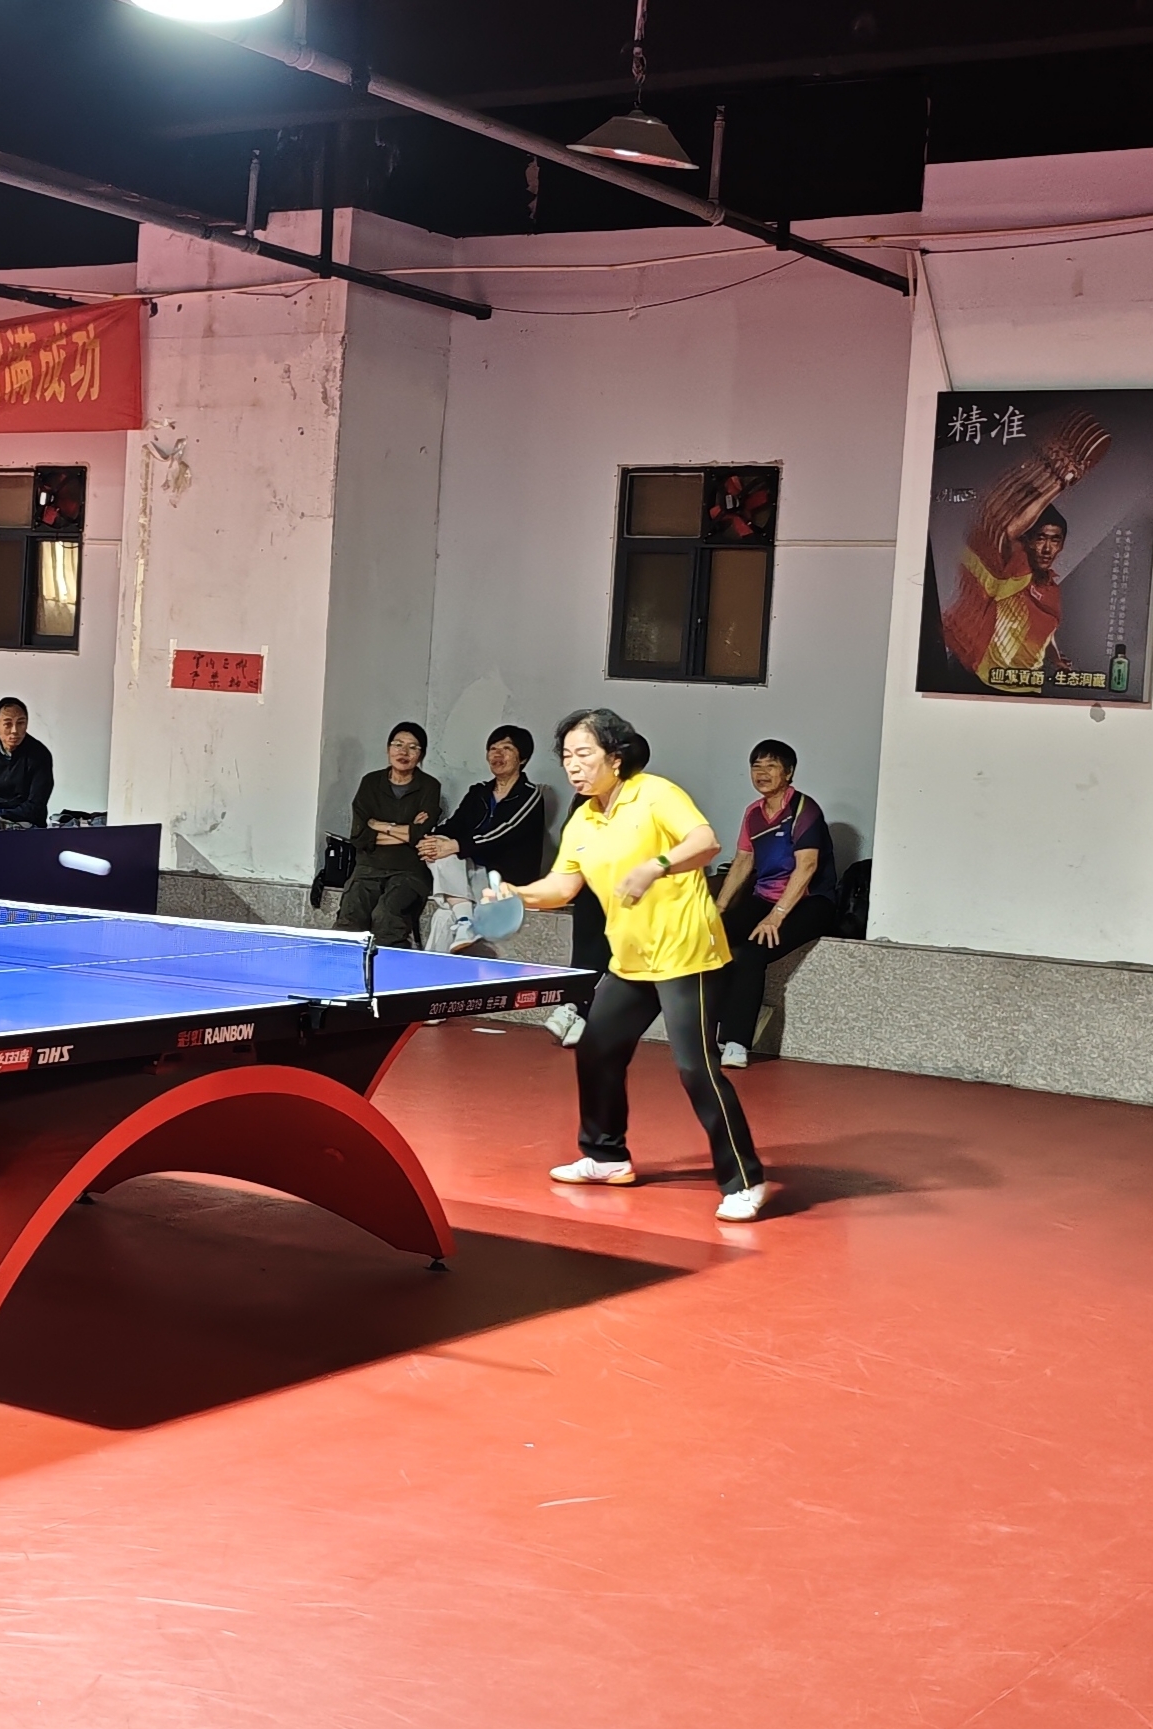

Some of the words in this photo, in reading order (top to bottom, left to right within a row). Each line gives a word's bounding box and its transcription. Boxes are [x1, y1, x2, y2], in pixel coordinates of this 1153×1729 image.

[947, 404, 1027, 445] 精准
[540, 989, 565, 1004] DHS
[204, 1023, 255, 1045] RAINBOW
[37, 1045, 75, 1065] DHS
